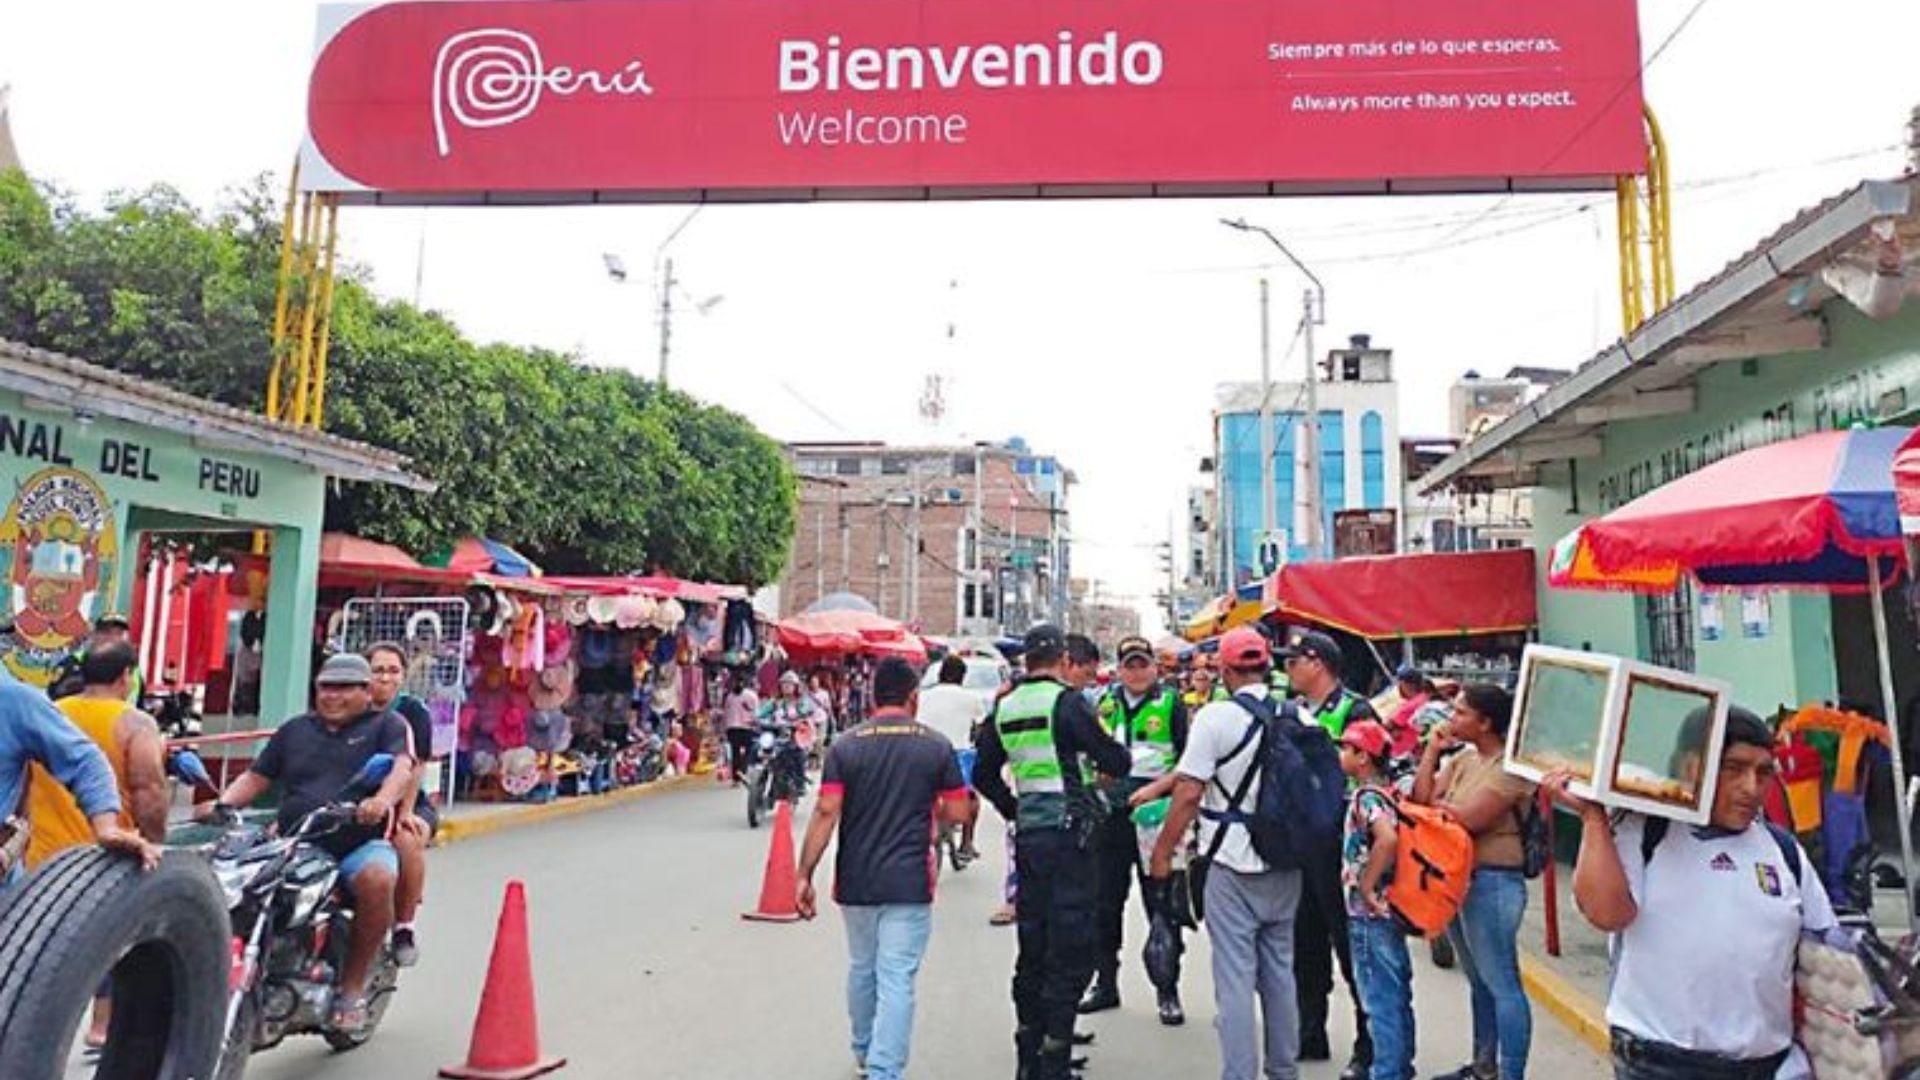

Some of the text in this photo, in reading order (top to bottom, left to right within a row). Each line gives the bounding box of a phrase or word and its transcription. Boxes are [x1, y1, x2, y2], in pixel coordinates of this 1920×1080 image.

[778, 30, 1164, 92] Bienvenido
[1267, 36, 1561, 60] Siempre más de lo que esperas.
[433, 29, 653, 156] Perú
[1291, 90, 1576, 111] Always more than you expect.
[778, 108, 967, 145] Welcome
[0, 415, 261, 499] NAL DEL PERU
